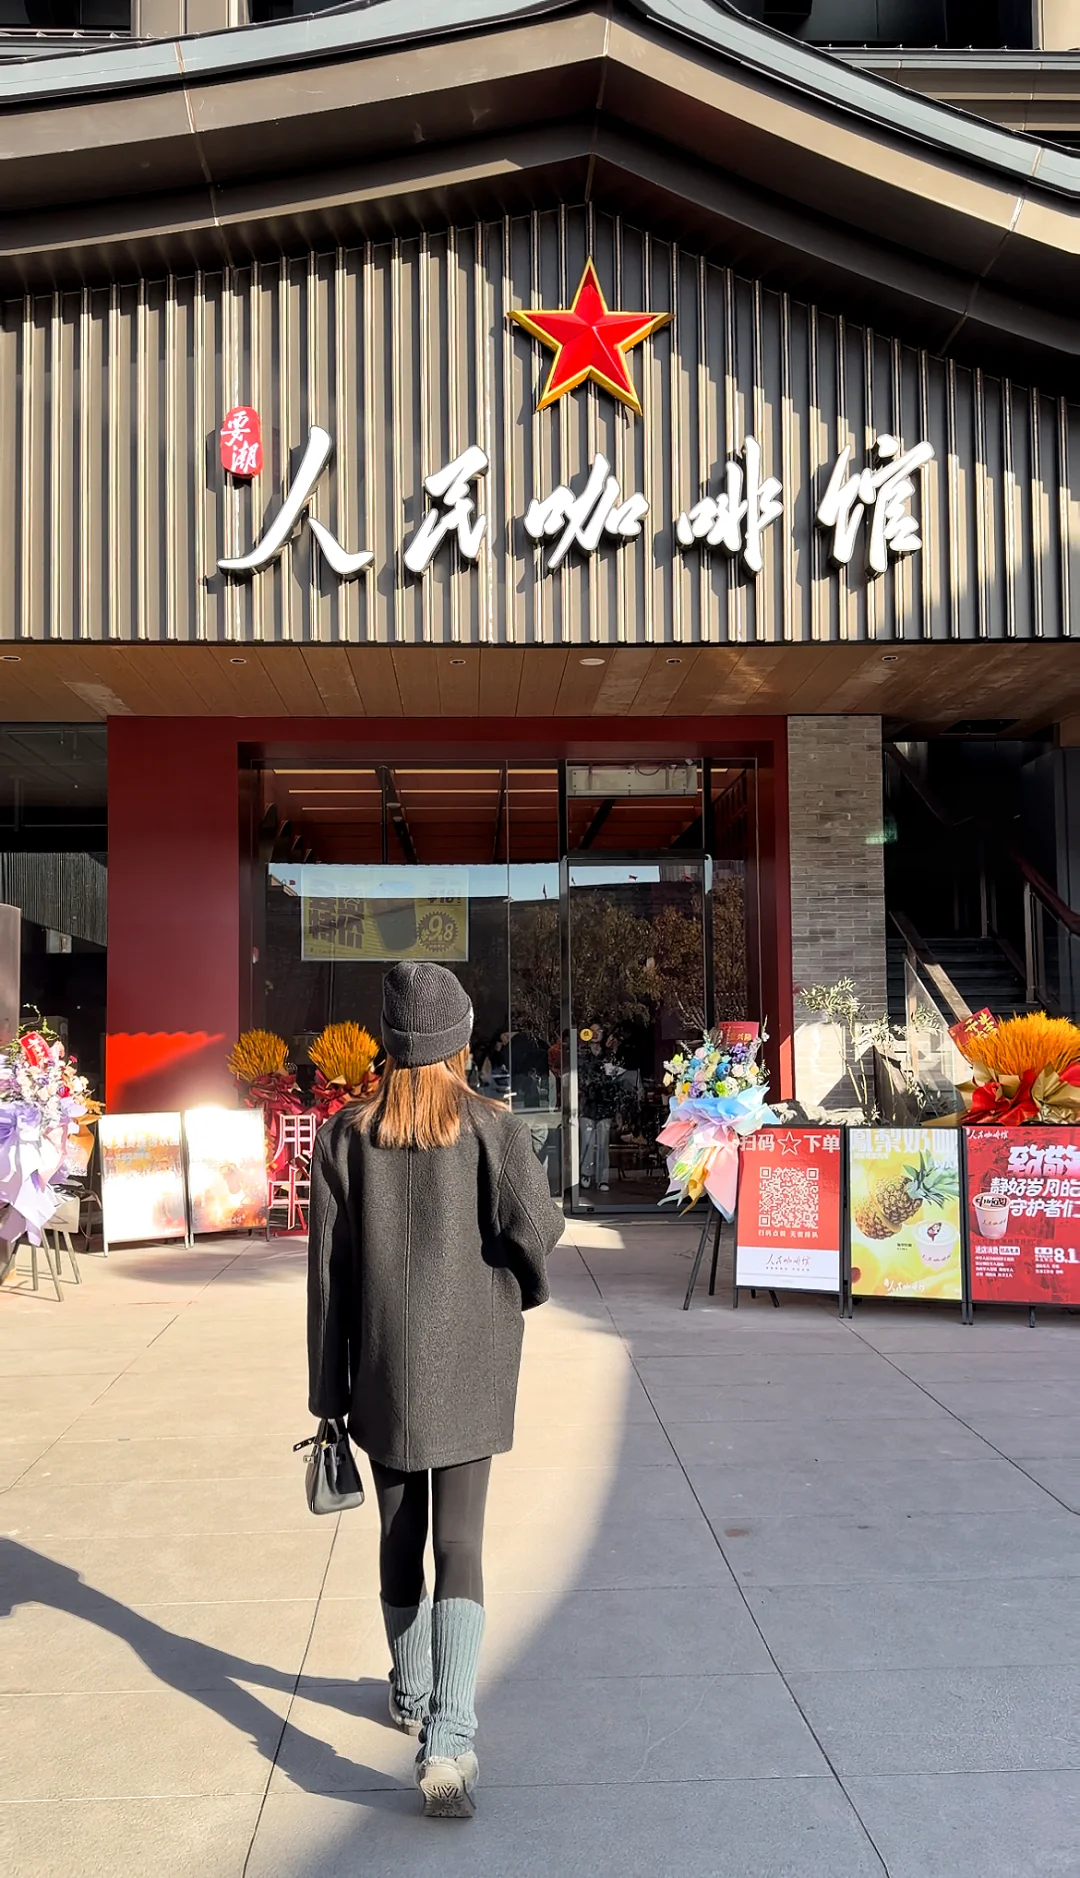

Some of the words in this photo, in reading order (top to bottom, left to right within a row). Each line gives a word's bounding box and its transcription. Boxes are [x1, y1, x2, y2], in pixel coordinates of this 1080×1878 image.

[217, 426, 935, 576] 人民咖啡馆
[740, 1134, 775, 1152] 扫码
[803, 1134, 841, 1154] 下单
